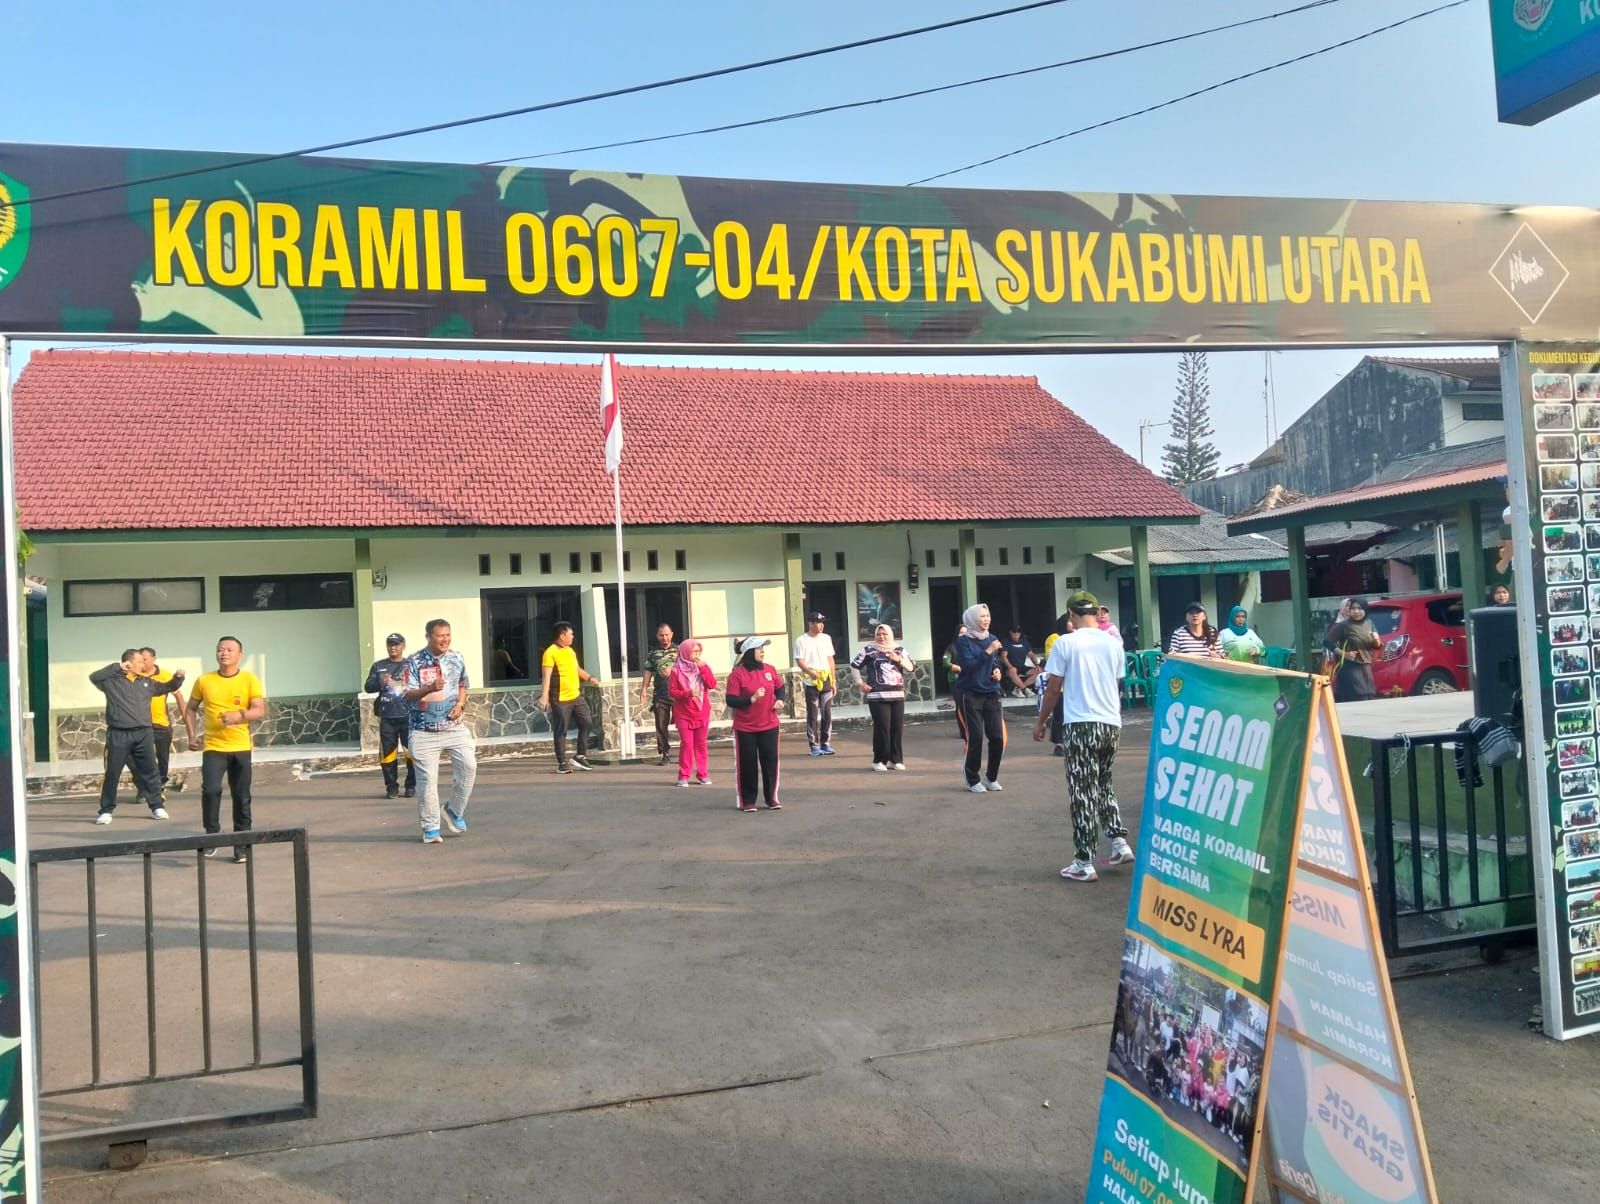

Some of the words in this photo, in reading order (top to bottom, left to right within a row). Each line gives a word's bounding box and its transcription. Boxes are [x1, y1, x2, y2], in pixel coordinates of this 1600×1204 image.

[152, 197, 486, 292] KORAMIL
[996, 228, 1268, 304] SUKABUMI
[1280, 234, 1432, 305] UTARA
[1160, 701, 1271, 770] SENAM
[1154, 757, 1254, 827] SEHAT
[1149, 851, 1210, 893] BERSAMA
[1151, 833, 1199, 866] CIKOLE
[1204, 834, 1271, 875] KORAMIL
[1152, 895, 1197, 932] MISS
[1200, 917, 1245, 959] LYRA
[1103, 1149, 1138, 1186] Pukul
[1140, 1176, 1174, 1204] 07.0
[1103, 1174, 1141, 1204] HALA
[1114, 1118, 1170, 1183] Setiap
[1172, 1168, 1214, 1204] Jum
